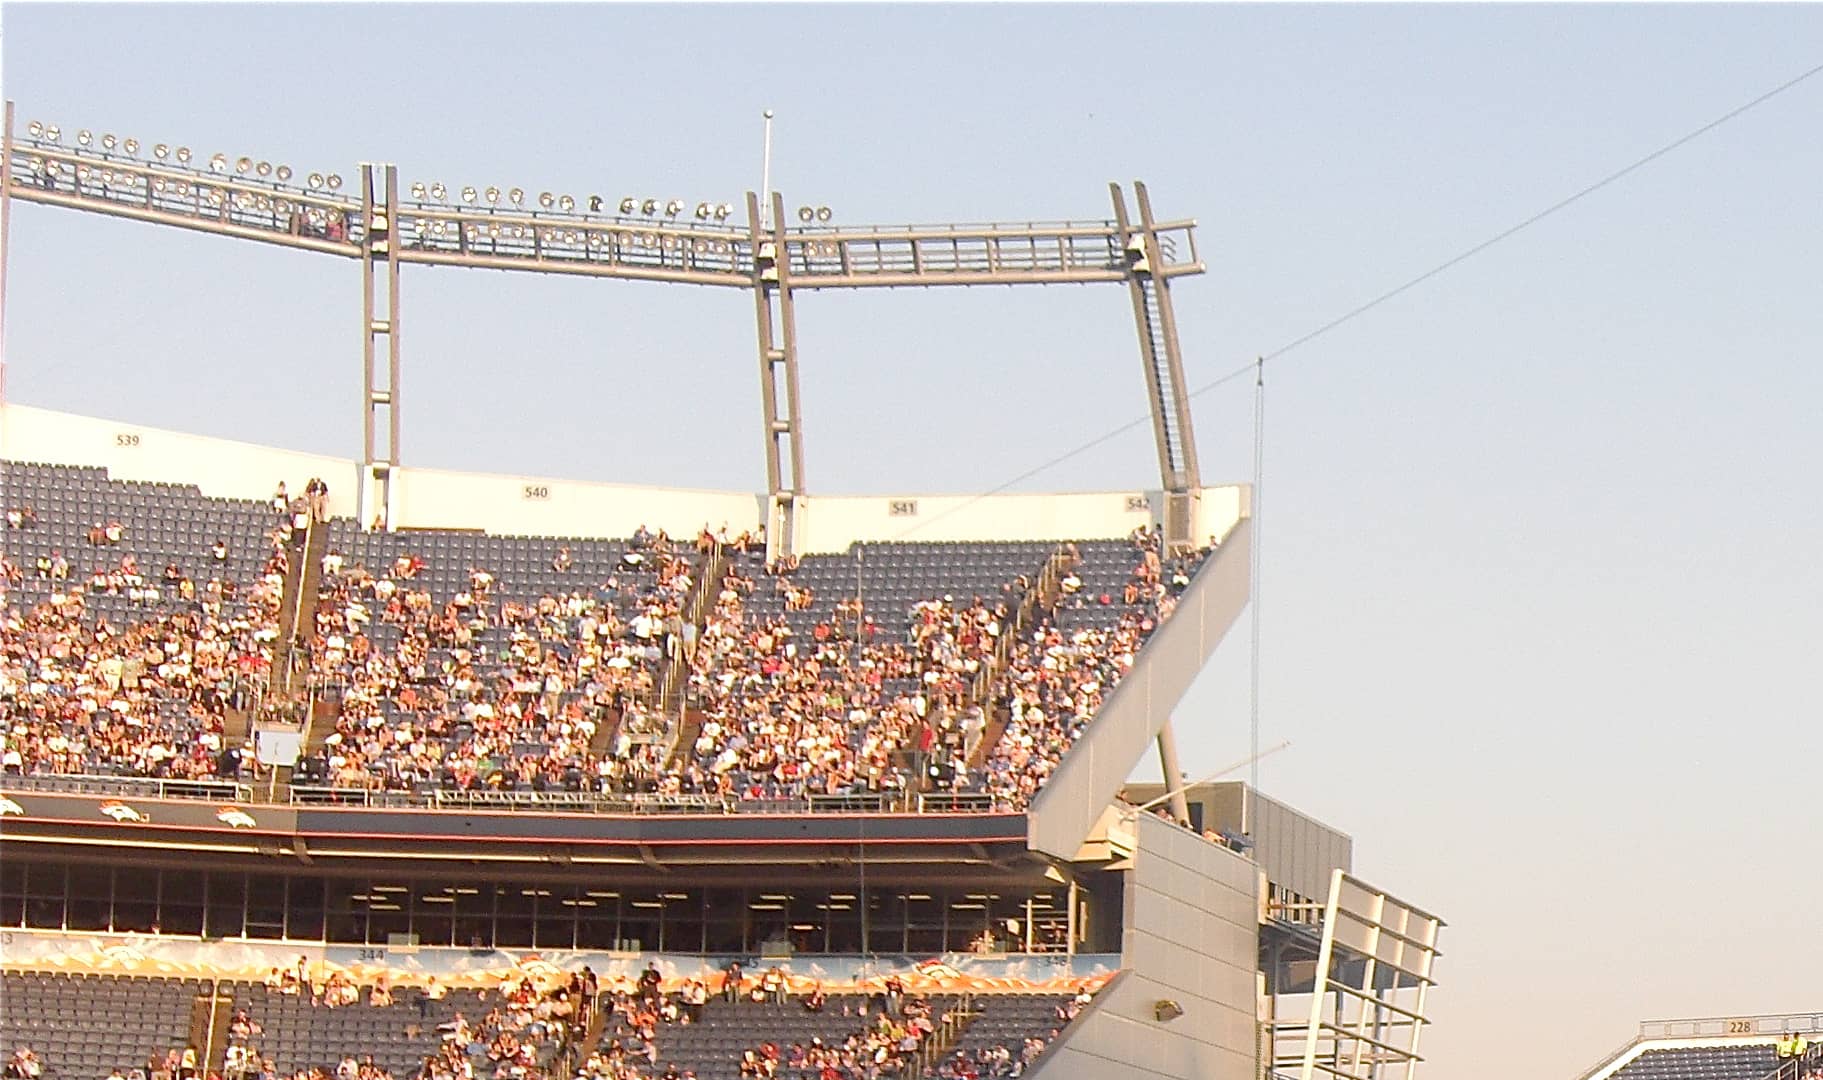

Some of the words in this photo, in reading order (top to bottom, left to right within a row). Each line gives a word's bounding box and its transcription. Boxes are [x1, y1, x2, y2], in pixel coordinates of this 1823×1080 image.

[117, 434, 140, 446] 539
[525, 486, 548, 499] 540
[892, 501, 916, 515] 541
[1730, 1021, 1751, 1033] 228
